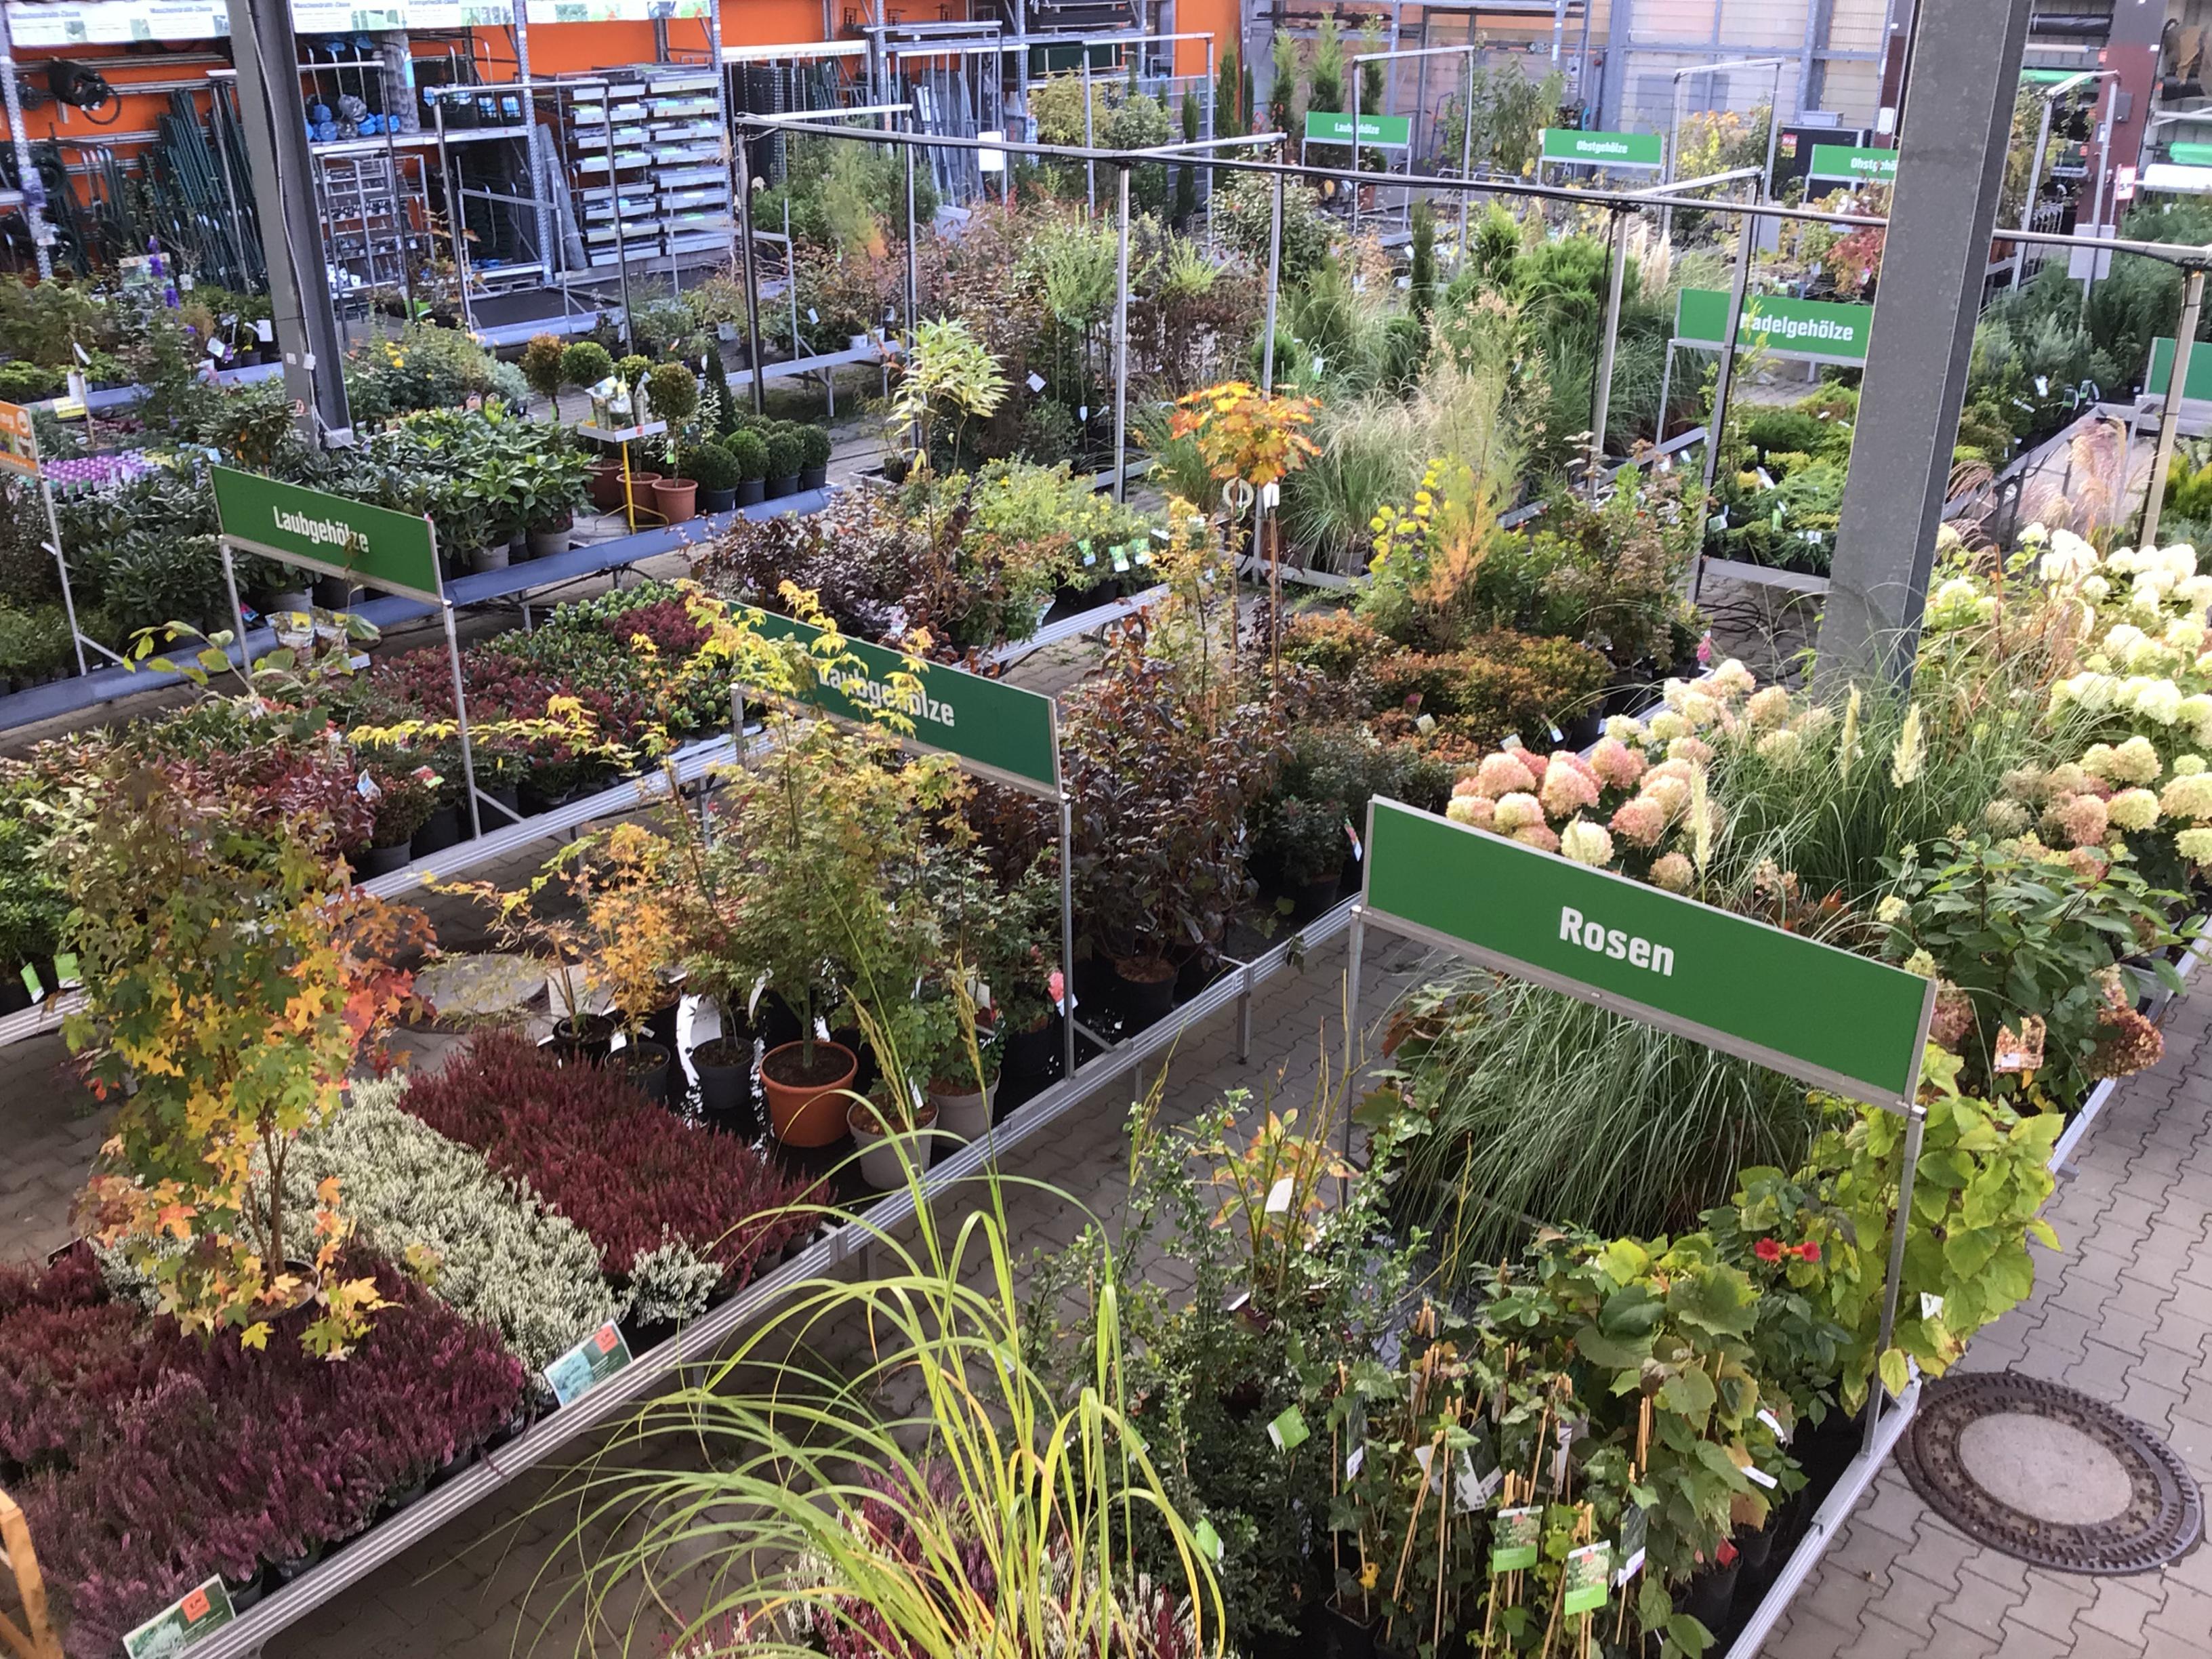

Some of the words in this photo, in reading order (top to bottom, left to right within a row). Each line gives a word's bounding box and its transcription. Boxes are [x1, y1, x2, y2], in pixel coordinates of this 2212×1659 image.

[1334, 122, 1380, 135] Laubhölze
[1576, 140, 1629, 155] Obstgehölze
[1559, 905, 1675, 977] Rosen
